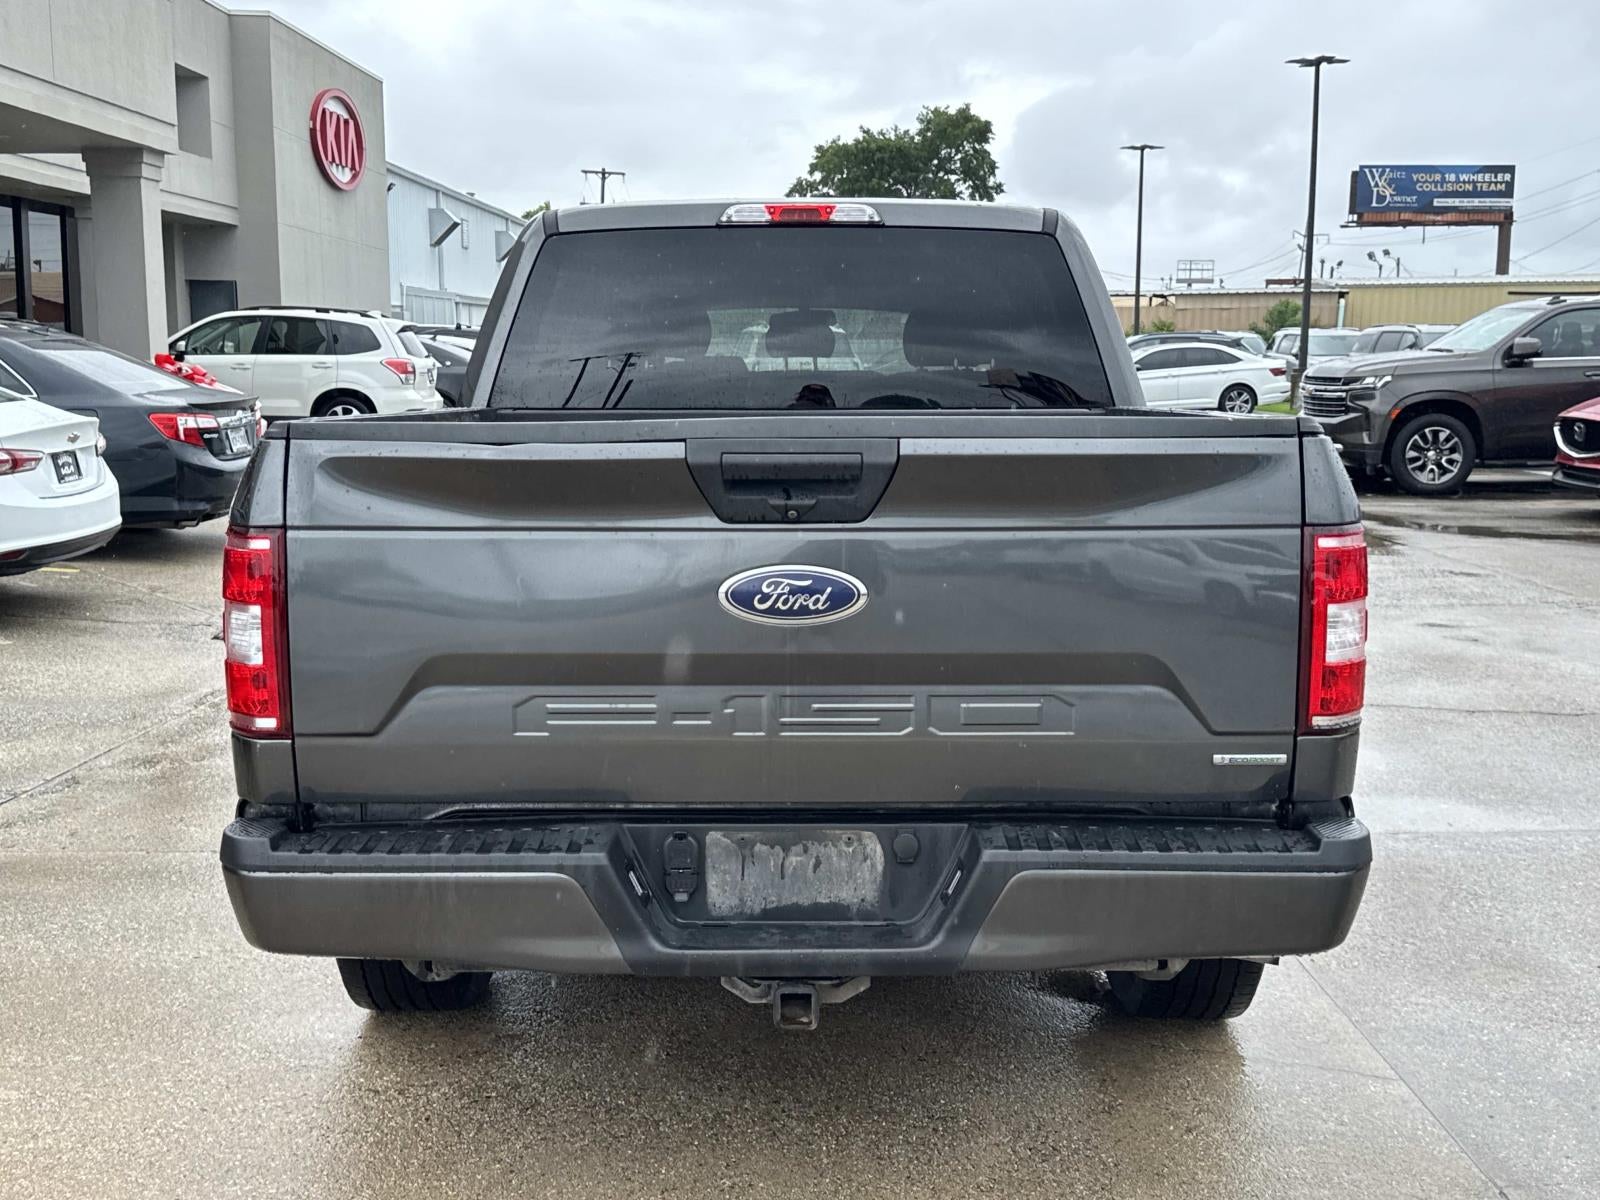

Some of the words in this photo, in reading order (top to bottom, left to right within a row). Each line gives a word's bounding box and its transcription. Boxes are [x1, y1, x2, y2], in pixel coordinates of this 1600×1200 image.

[325, 108, 360, 172] KIA
[1412, 173, 1442, 183] YOUR
[1444, 173, 1456, 182] 18
[1459, 173, 1512, 182] WHEELER
[1416, 182, 1473, 191] COLLISION
[1476, 182, 1506, 191] TEAM
[753, 577, 832, 611] Ford
[511, 694, 1076, 736] F-150
